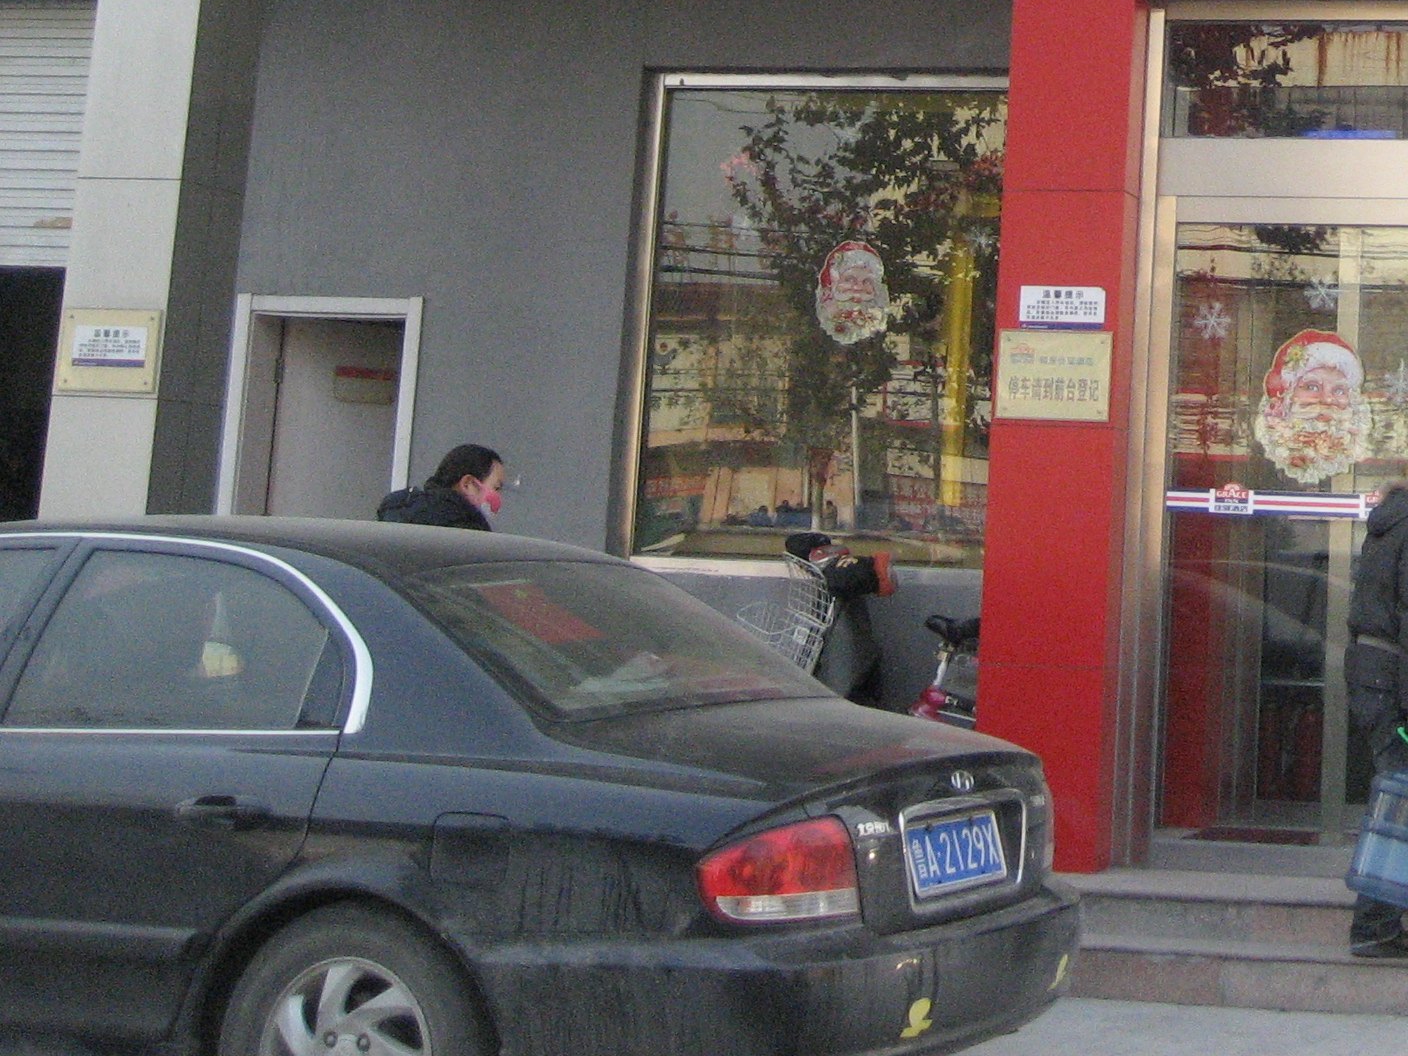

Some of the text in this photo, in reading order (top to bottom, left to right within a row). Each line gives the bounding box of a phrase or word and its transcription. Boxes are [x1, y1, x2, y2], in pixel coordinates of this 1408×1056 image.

[1042, 290, 1084, 299] 温馨提示
[1008, 376, 1100, 403] 停车请到前台登记
